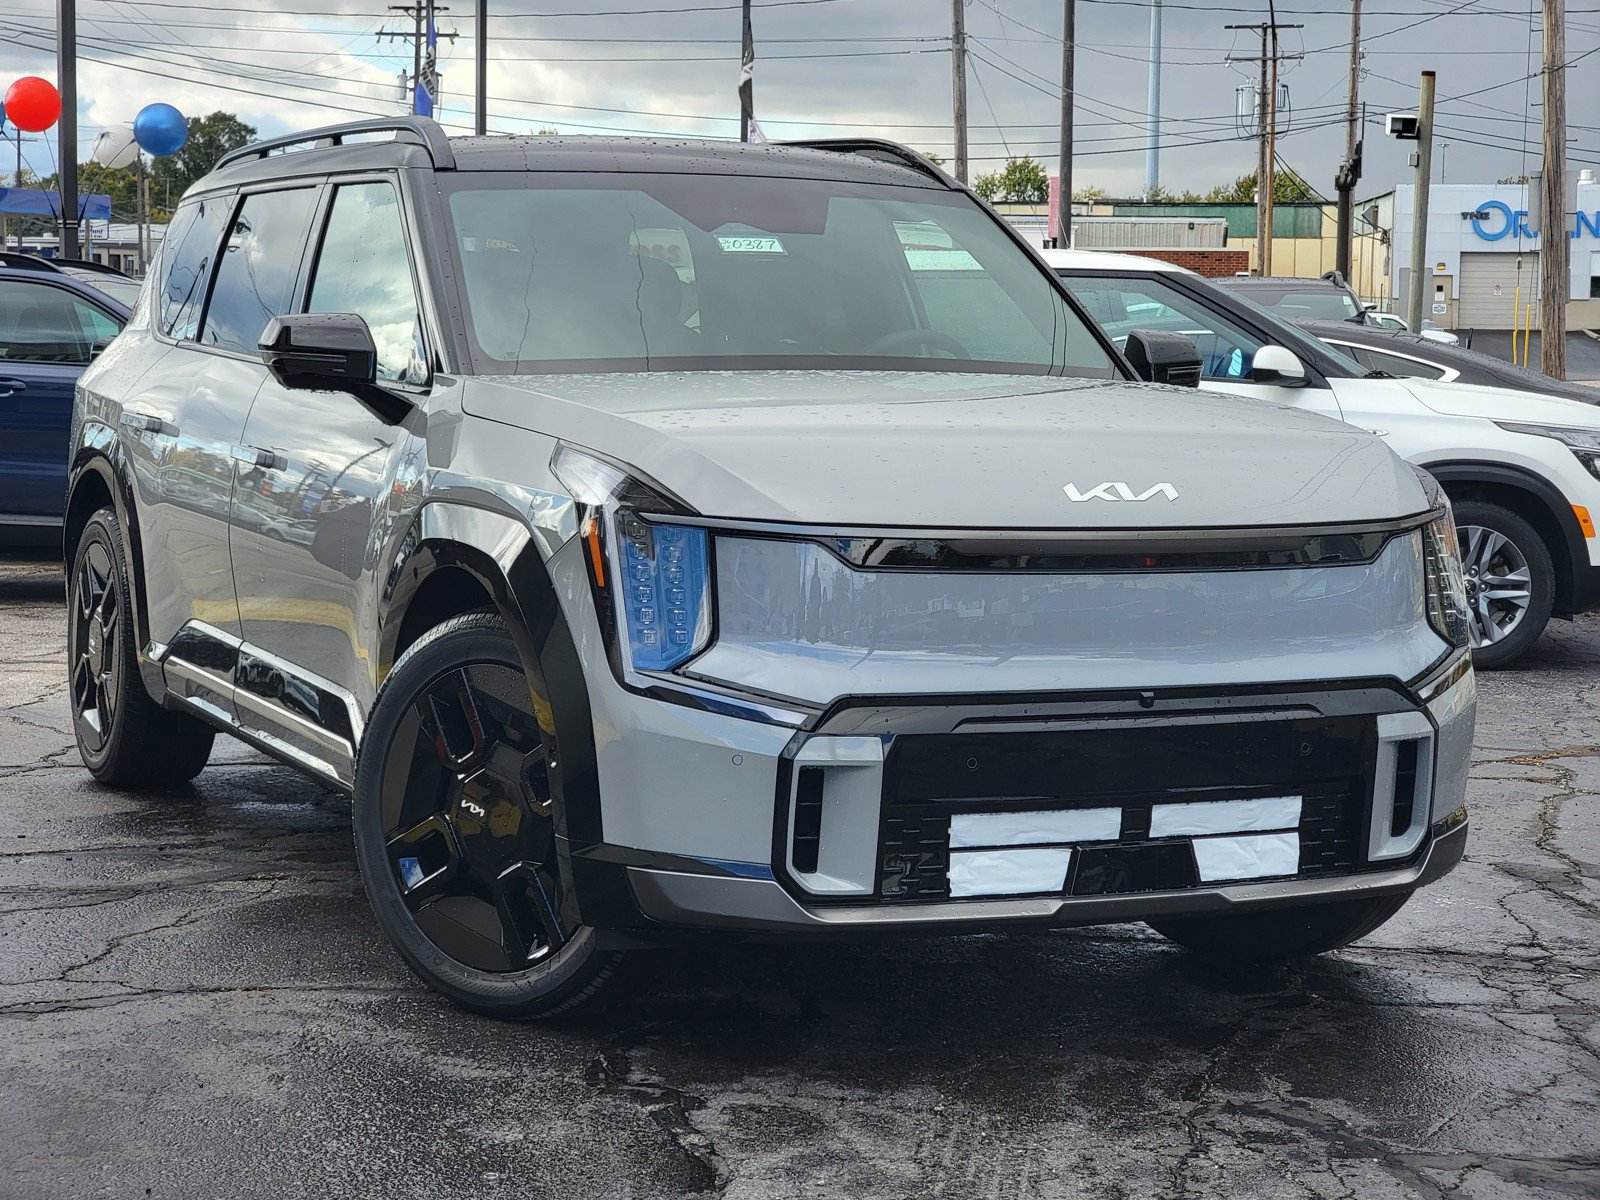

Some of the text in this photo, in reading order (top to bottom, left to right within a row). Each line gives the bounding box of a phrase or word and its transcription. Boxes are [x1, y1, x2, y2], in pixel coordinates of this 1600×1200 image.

[1461, 211, 1490, 220] THE
[1062, 482, 1180, 502] KIA
[461, 799, 485, 817] KIA
